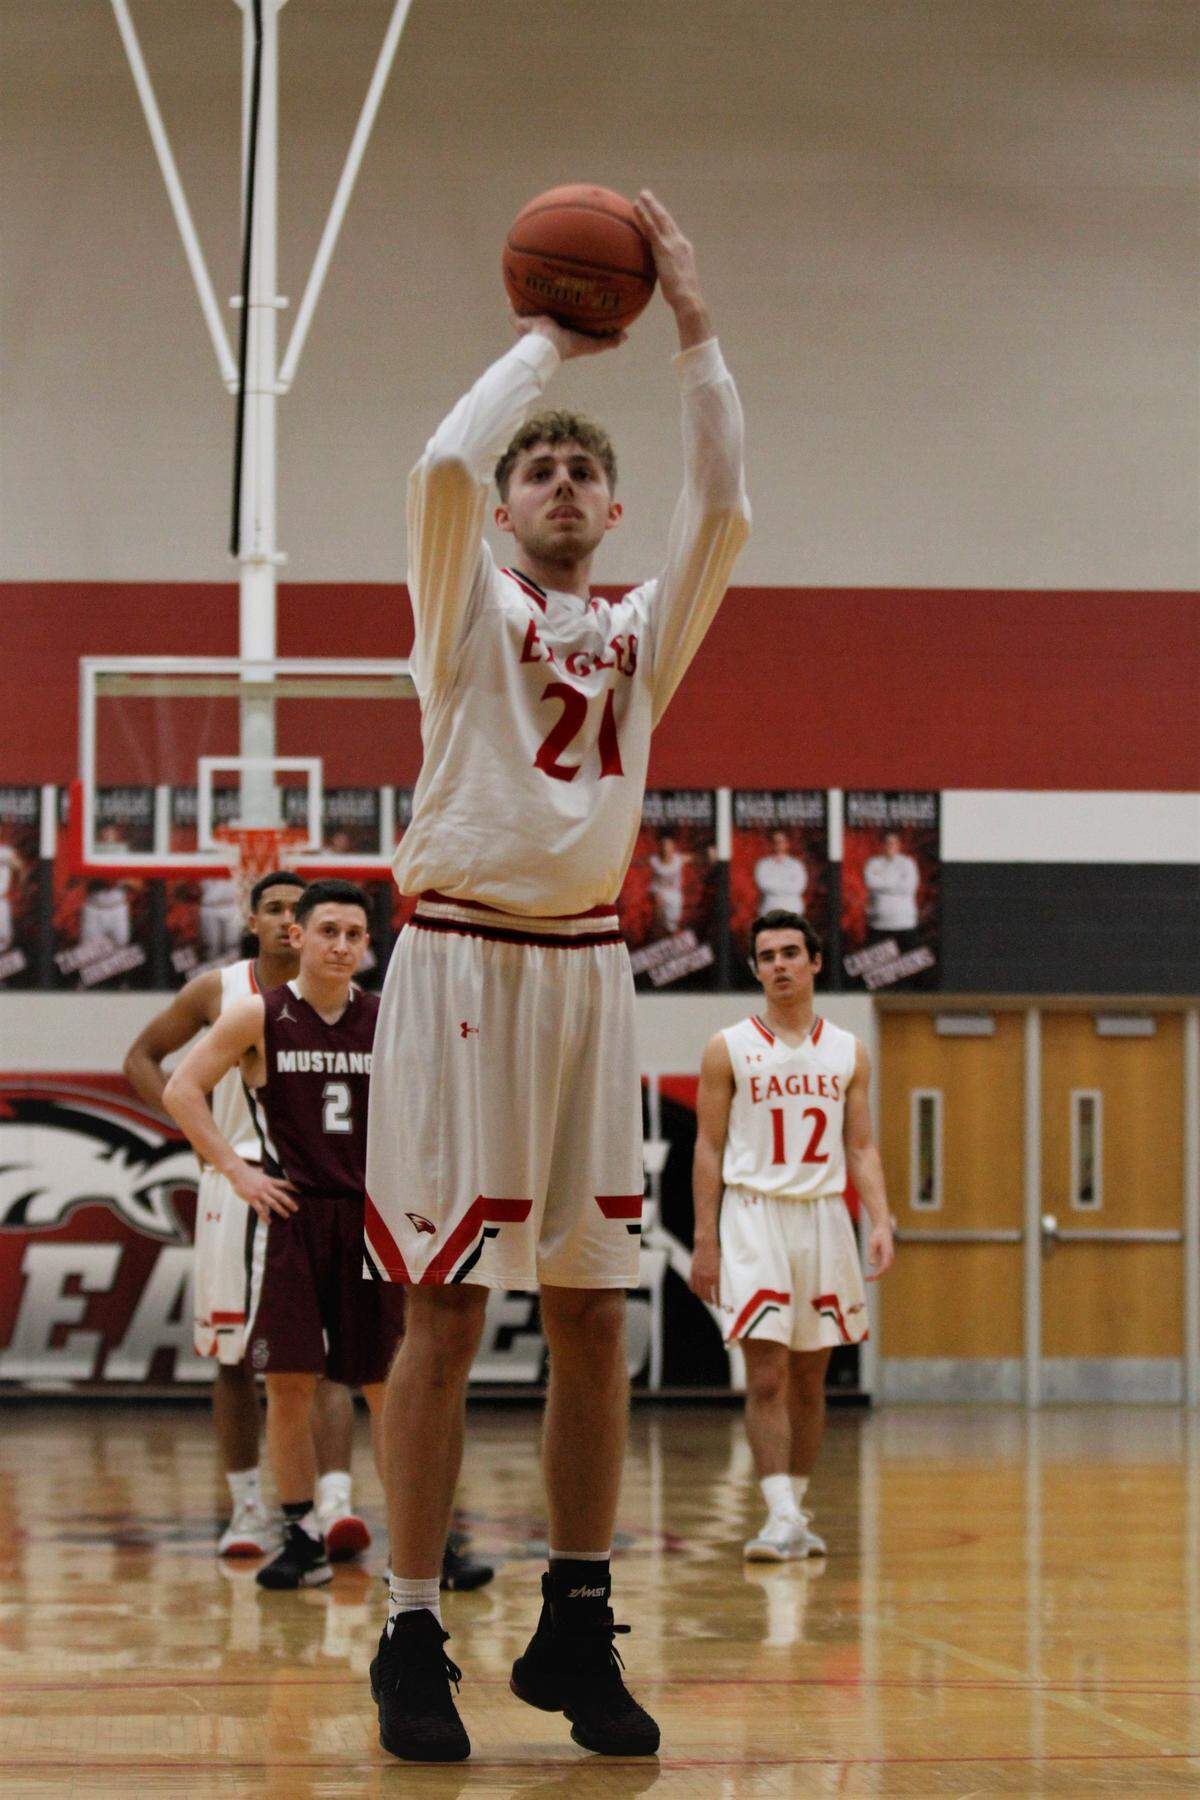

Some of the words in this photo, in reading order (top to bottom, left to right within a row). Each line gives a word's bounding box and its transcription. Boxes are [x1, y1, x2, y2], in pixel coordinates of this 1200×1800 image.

[533, 682, 624, 782] 21
[322, 1082, 353, 1134] 2
[750, 1074, 840, 1104] EAGLES
[770, 1107, 830, 1165] 12
